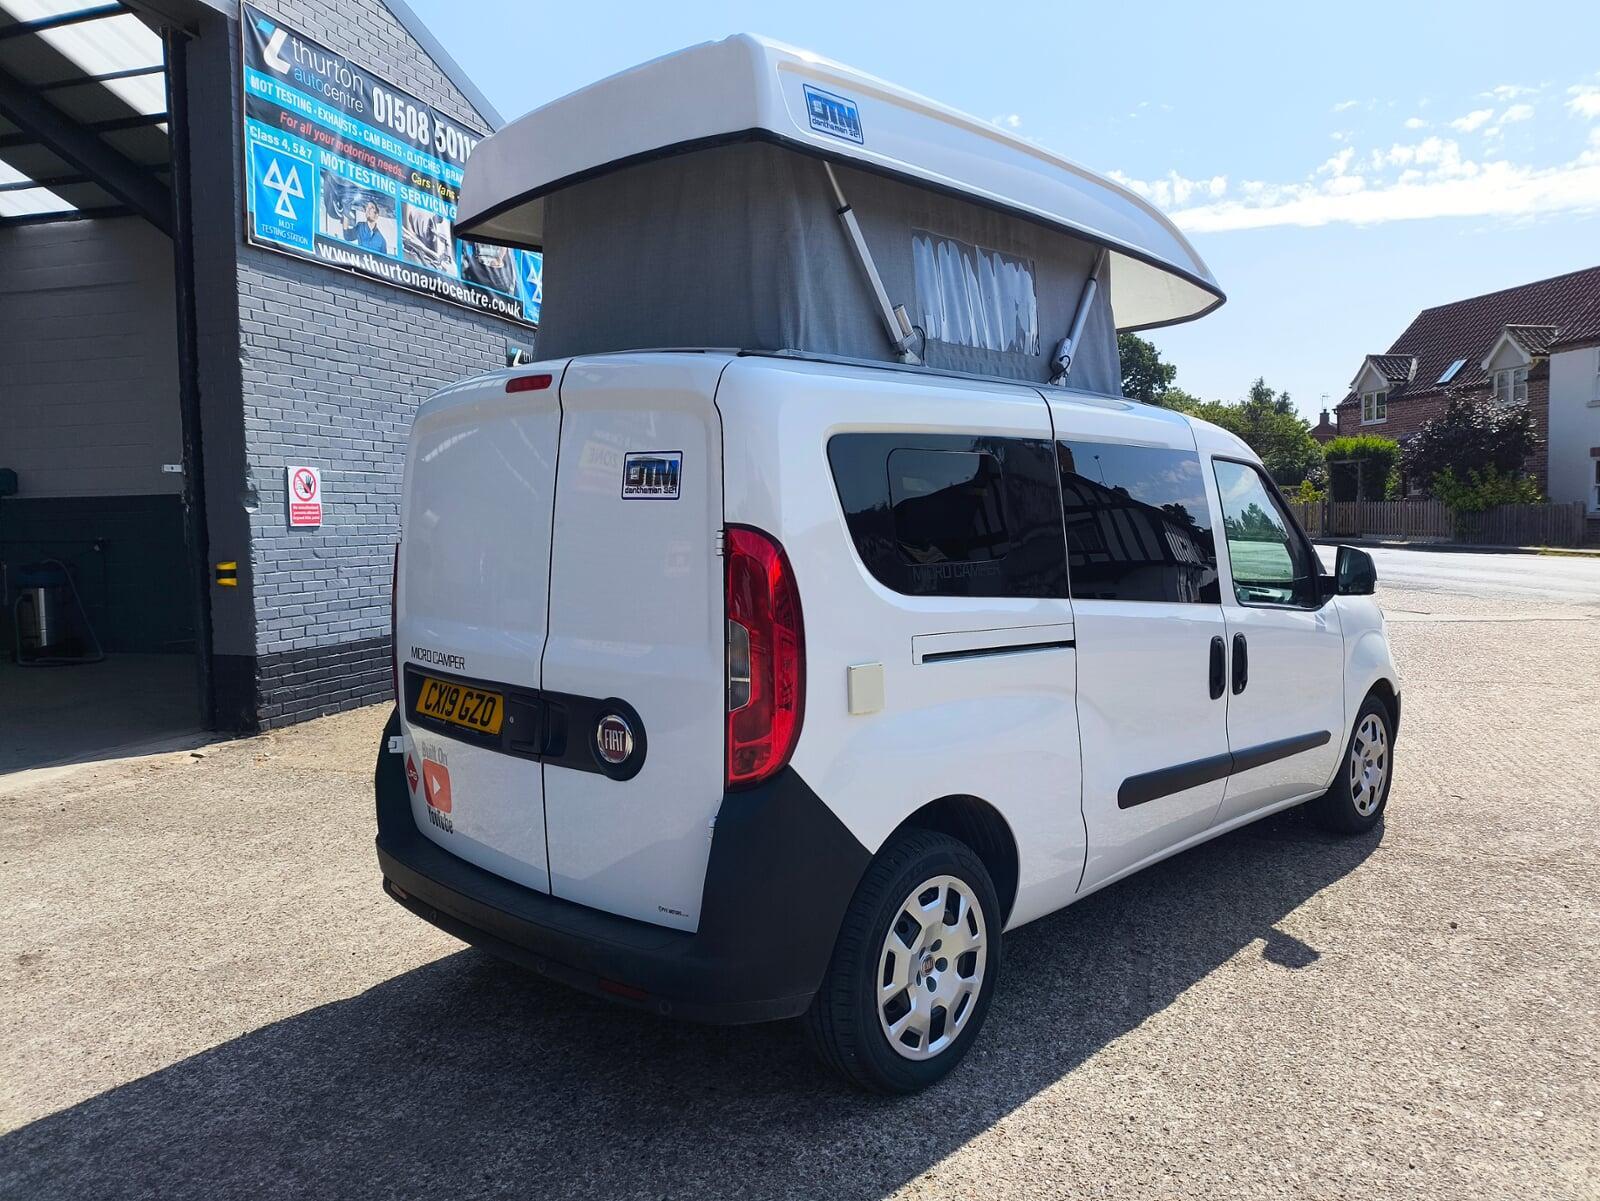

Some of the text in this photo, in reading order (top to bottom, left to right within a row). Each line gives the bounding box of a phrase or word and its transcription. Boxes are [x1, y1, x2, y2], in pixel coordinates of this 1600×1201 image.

[292, 37, 364, 96] thurton
[294, 67, 364, 113] autocentre
[249, 125, 280, 146] Class
[250, 75, 273, 97] MOT
[276, 86, 312, 114] TESTING
[317, 107, 358, 137] EXHAUSTS
[363, 130, 380, 147] CAM
[381, 138, 402, 157] BELTS
[407, 150, 441, 175] CLUTCHES
[372, 86, 430, 146] 01508
[280, 111, 298, 129] For
[300, 119, 312, 136] all
[313, 129, 334, 147] your
[335, 140, 376, 168] motoring
[320, 150, 457, 218] MOT TESTING SERVICING
[411, 172, 456, 200] Cars Vans
[261, 223, 309, 246] TESTING STATION
[318, 242, 522, 318] www.thurtonautocentre.co.uk
[410, 645, 466, 670] MICRO CAMPER
[424, 682, 460, 717] CX19
[437, 746, 449, 764] On
[604, 728, 625, 752] FIAT
